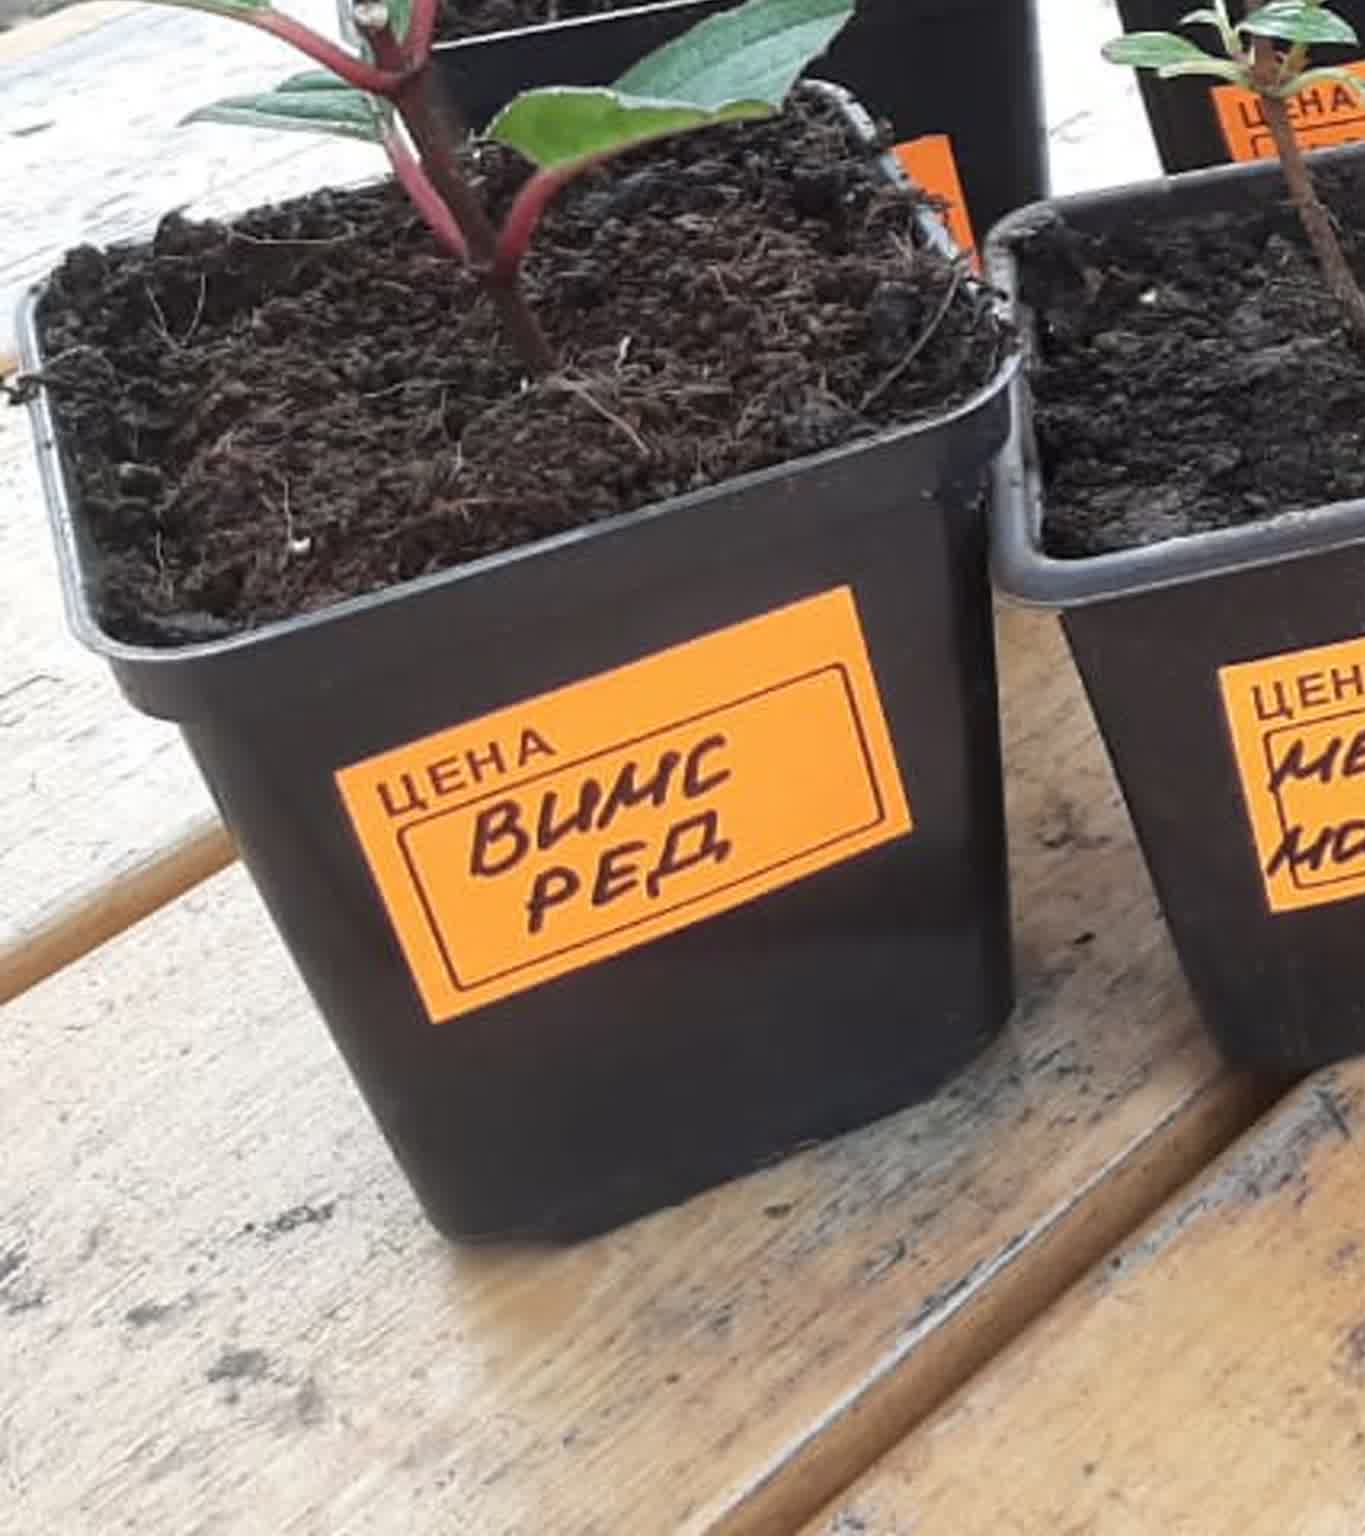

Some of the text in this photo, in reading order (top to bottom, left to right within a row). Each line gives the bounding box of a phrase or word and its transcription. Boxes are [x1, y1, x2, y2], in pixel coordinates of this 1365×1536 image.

[1238, 84, 1358, 130] ЦНА
[375, 728, 557, 818] ЦЕНА
[468, 733, 733, 877] ВИМС
[525, 810, 732, 934] РЕД
